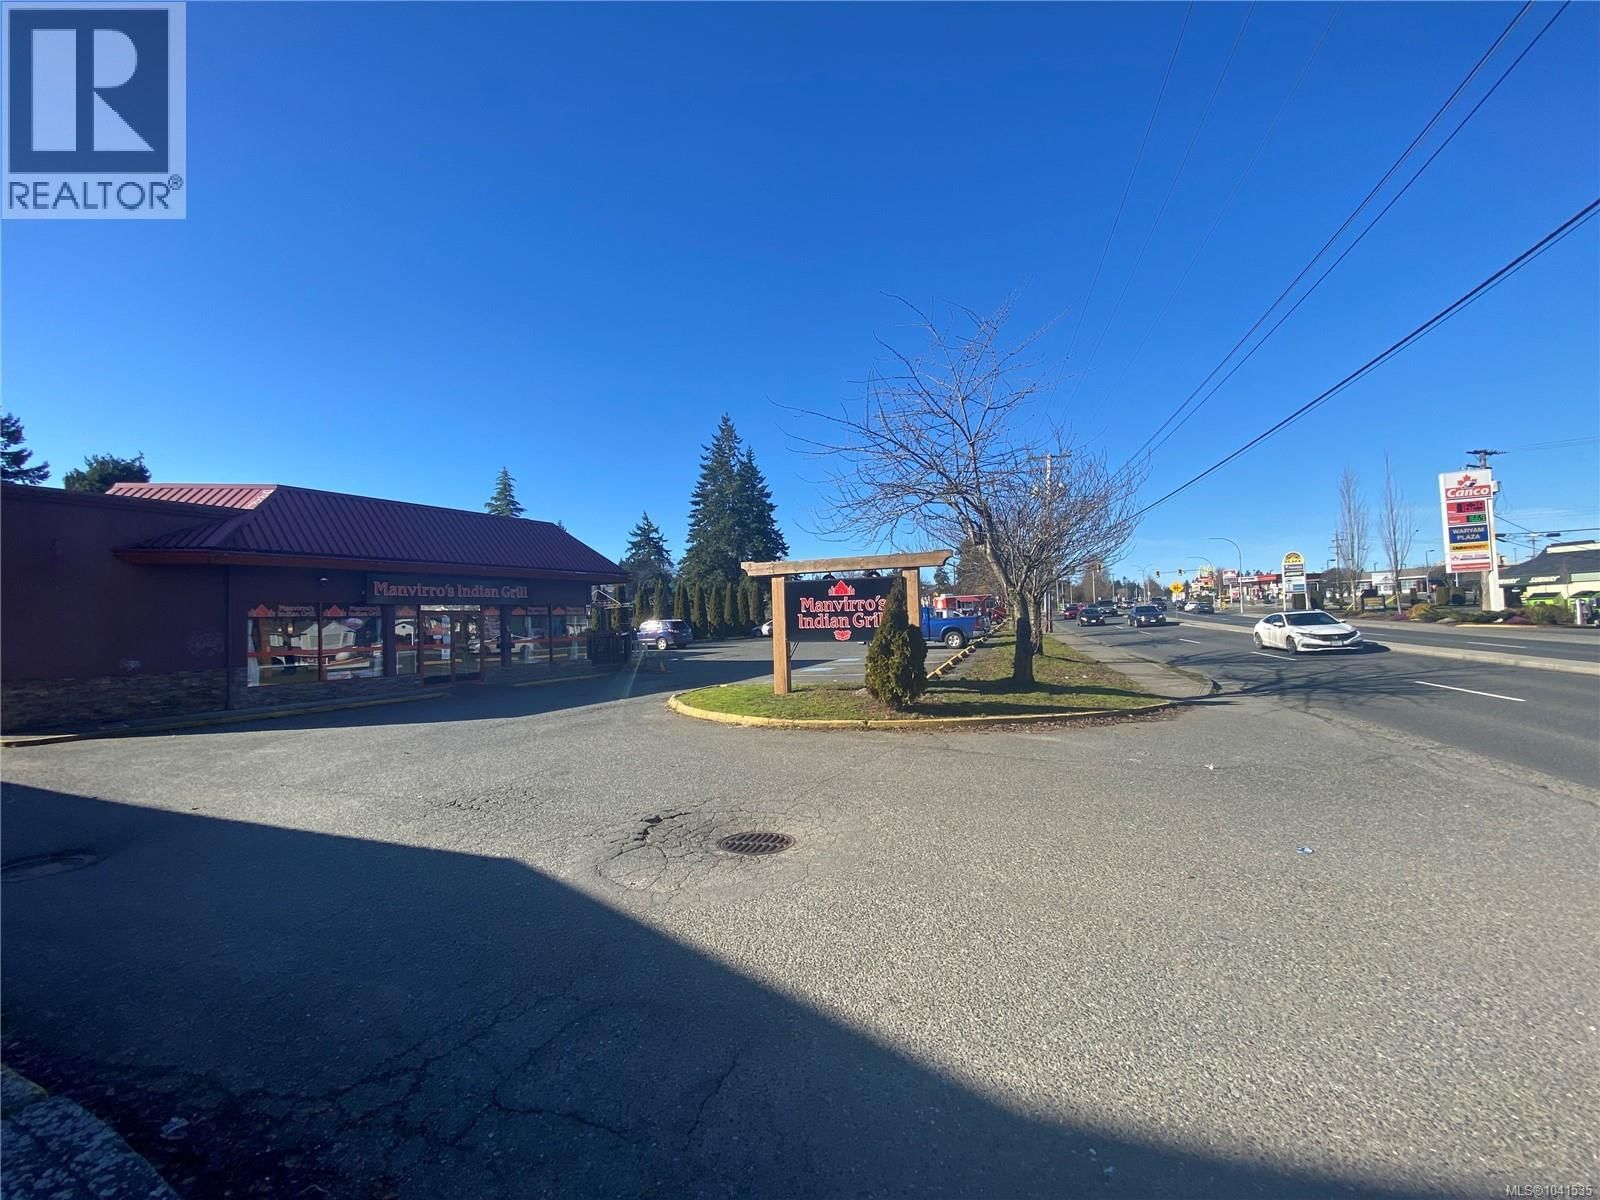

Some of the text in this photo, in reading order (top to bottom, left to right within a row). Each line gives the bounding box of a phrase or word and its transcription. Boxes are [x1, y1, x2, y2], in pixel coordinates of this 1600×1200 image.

[1447, 488, 1489, 497] Canco
[374, 581, 529, 599] Manvirro's Indian Grill
[800, 596, 886, 612] Manvirro's
[798, 612, 883, 628] Indian Gril
